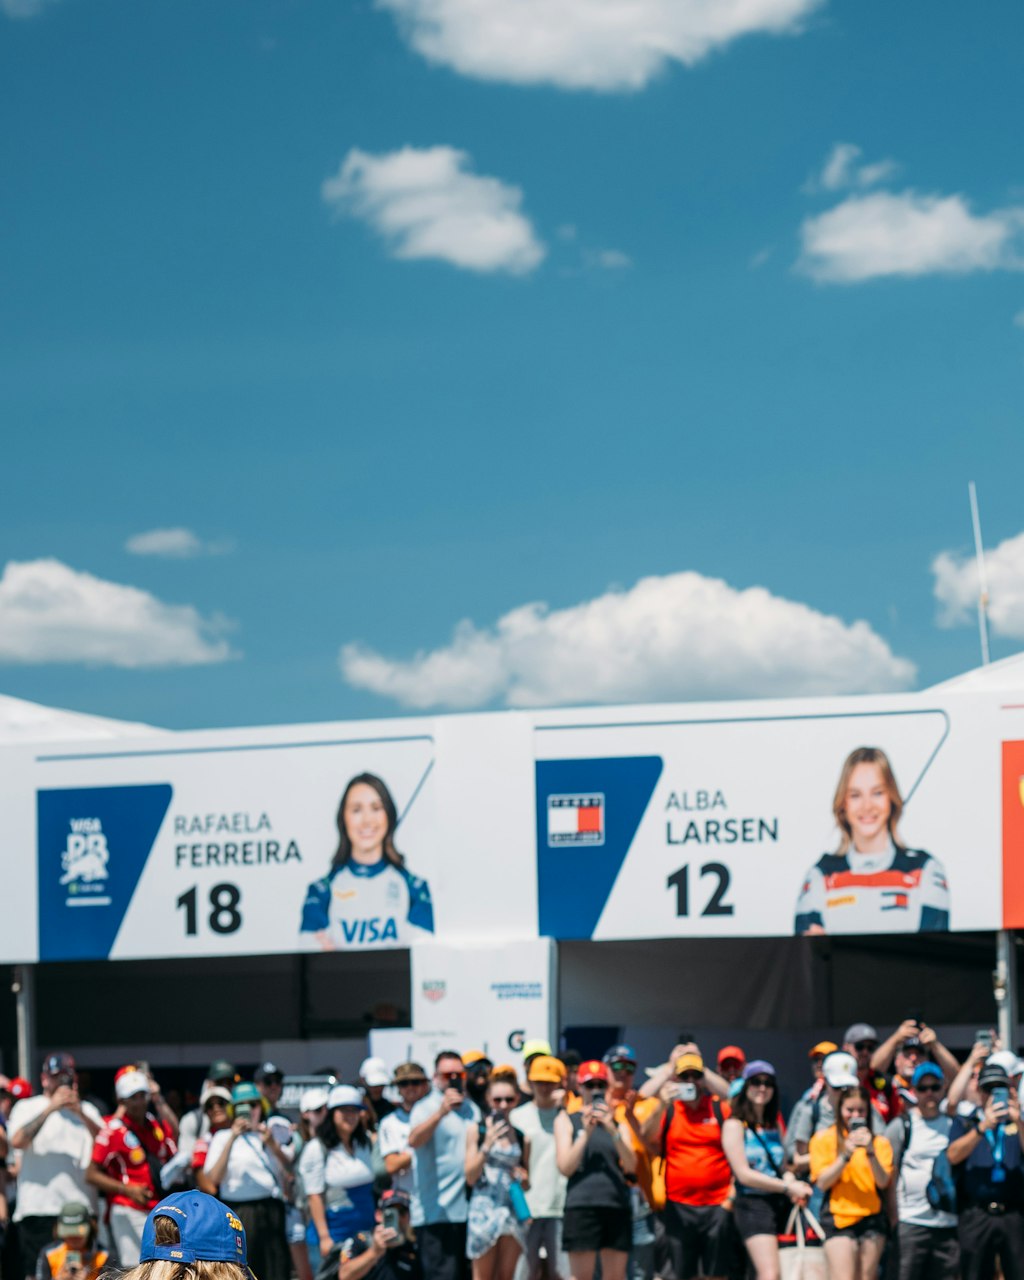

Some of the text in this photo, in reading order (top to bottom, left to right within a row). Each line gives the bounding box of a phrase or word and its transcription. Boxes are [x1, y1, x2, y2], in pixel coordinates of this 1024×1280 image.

[665, 790, 727, 812] ALBA
[174, 813, 273, 836] RAFAELA
[666, 818, 780, 846] LARSEN
[175, 840, 302, 868] FERREIRA
[666, 862, 735, 918] 12
[176, 883, 242, 936] 18
[341, 918, 398, 944] VISA
